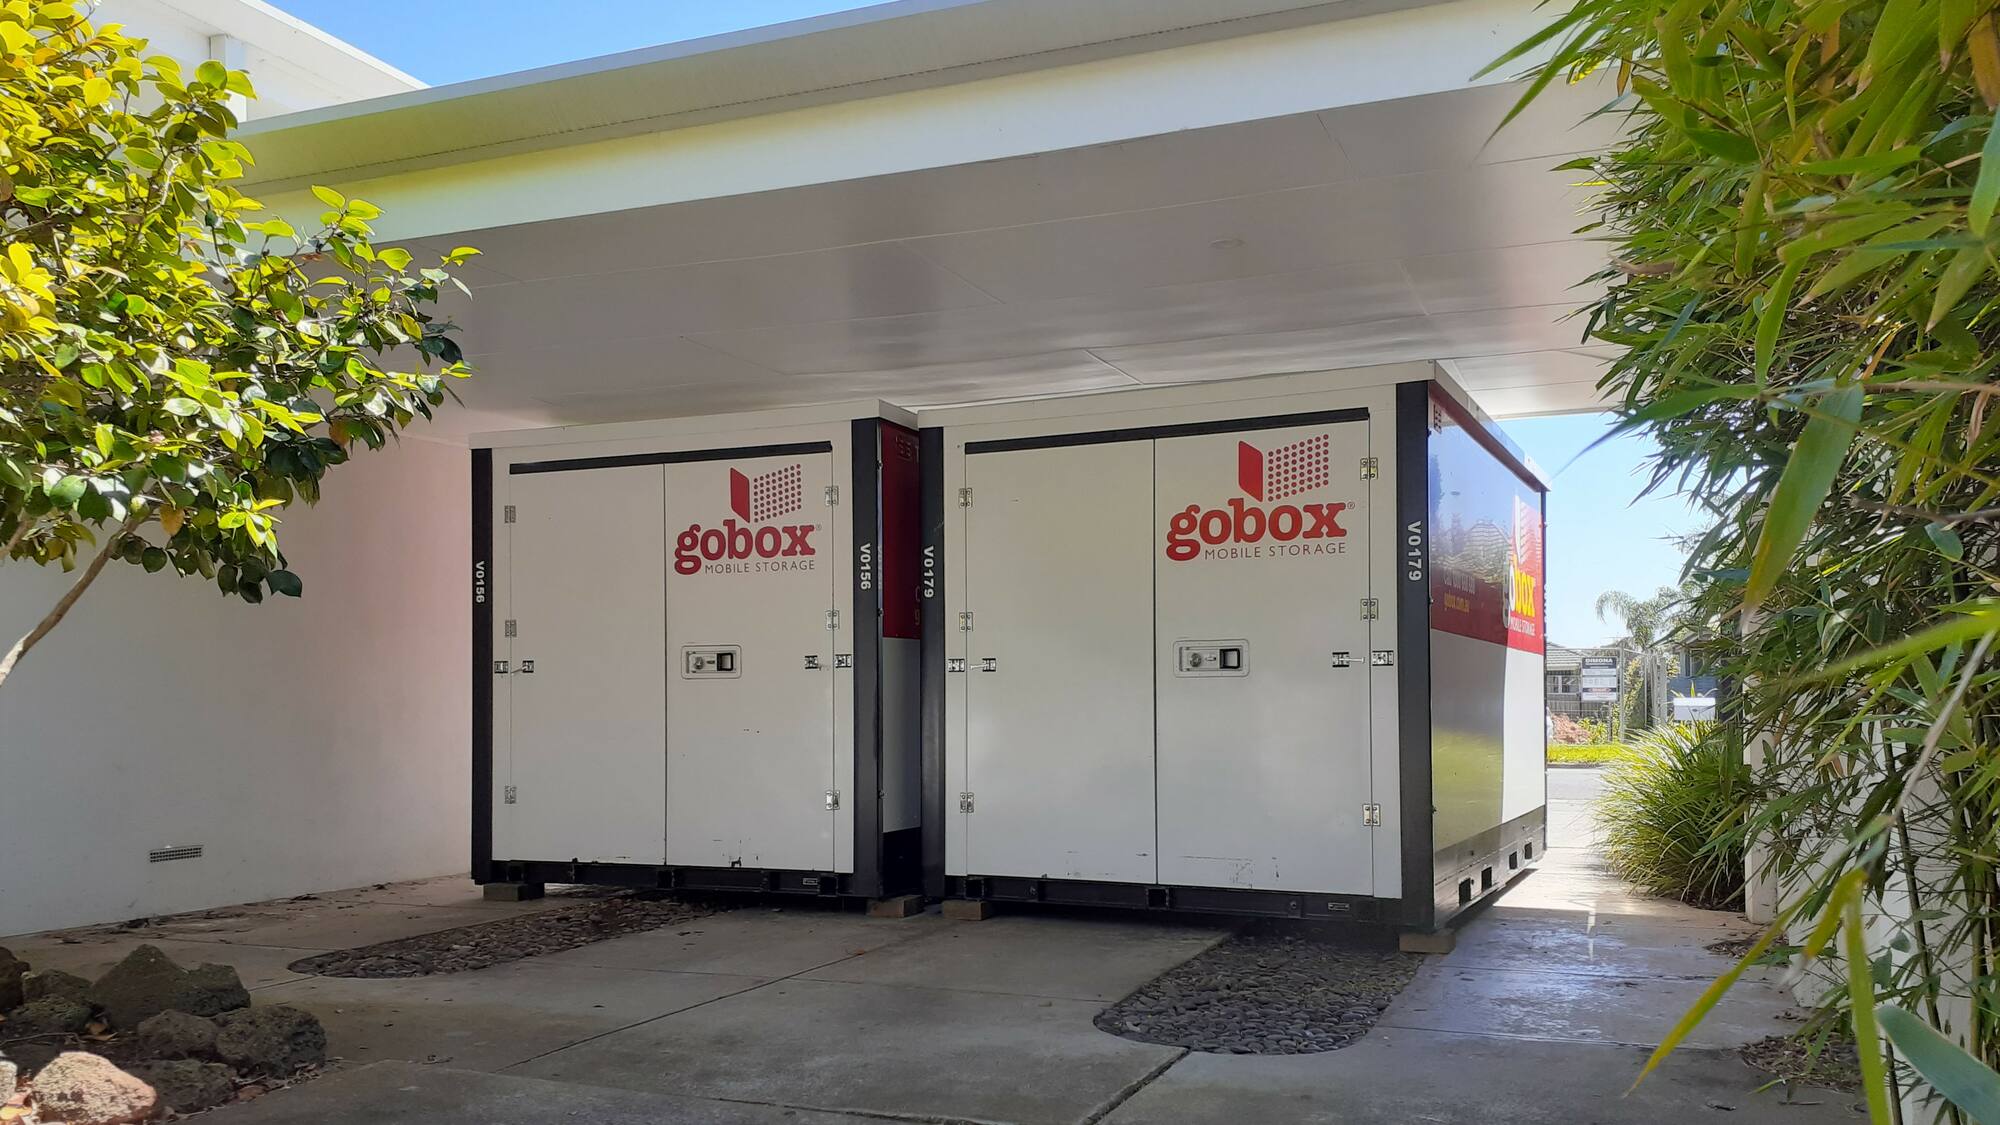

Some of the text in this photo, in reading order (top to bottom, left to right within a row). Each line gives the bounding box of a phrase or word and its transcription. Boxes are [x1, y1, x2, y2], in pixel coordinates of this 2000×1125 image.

[674, 519, 816, 575] gobox
[1166, 497, 1347, 561] gobox
[1204, 543, 1346, 560] MOBILE STORAGE
[1407, 520, 1422, 581] V0179
[475, 560, 485, 603] V0156
[705, 560, 816, 574] MOBILE STORAGE
[860, 543, 871, 590] V0156
[924, 545, 934, 598] V0179
